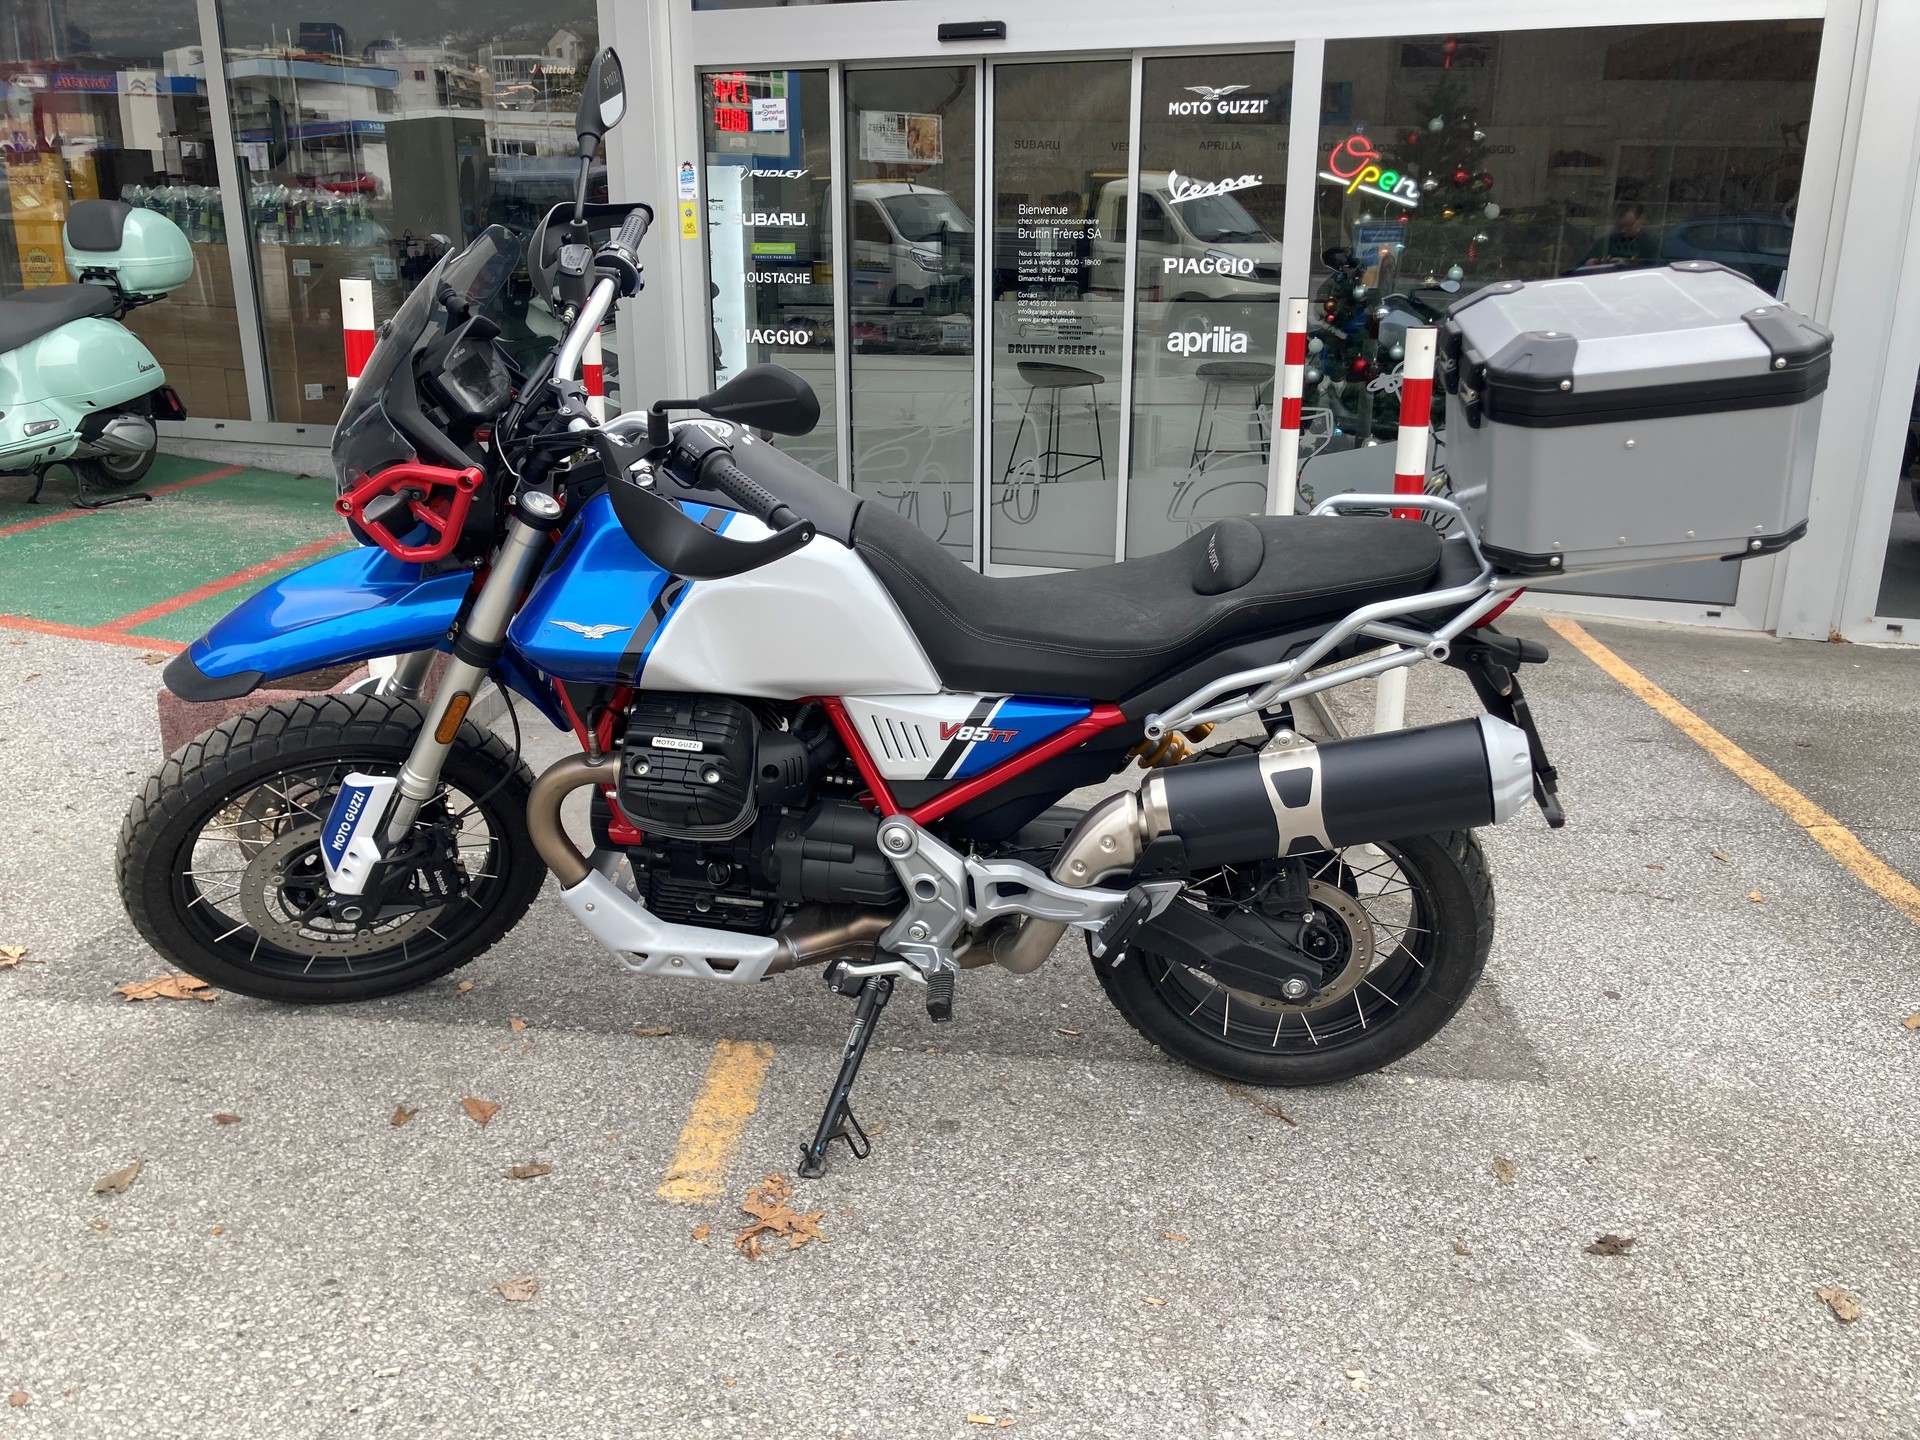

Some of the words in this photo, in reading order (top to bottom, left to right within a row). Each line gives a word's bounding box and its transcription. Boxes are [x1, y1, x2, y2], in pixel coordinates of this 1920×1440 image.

[1168, 101, 1212, 115] MOTO
[1217, 100, 1264, 114] GUZZI
[1014, 139, 1060, 150] SUBARU
[1199, 141, 1242, 151] APRILIA
[1329, 135, 1421, 198] Open
[748, 169, 809, 179] RIDLEY
[1167, 169, 1262, 205] Vespa
[1018, 203, 1069, 215] Bienvenue
[1017, 217, 1032, 225] chez
[1050, 217, 1100, 225] concessionnaire
[1018, 227, 1050, 239] Bruttin
[1053, 227, 1085, 239] Frères
[1087, 227, 1102, 239] SA
[1064, 258, 1080, 266] 8h00
[1084, 258, 1102, 266] 18h00
[1018, 266, 1038, 274] Samedi
[1041, 266, 1056, 274] 8h00
[1061, 266, 1078, 274] 13h00
[1047, 274, 1066, 282] Fermé
[1167, 326, 1248, 357] aprilia
[1007, 343, 1056, 354] BRUTTIN
[1058, 344, 1097, 355] FRERES
[678, 741, 700, 749] GUZZI
[331, 821, 351, 851] MOTO
[344, 790, 366, 822] GUZZI
